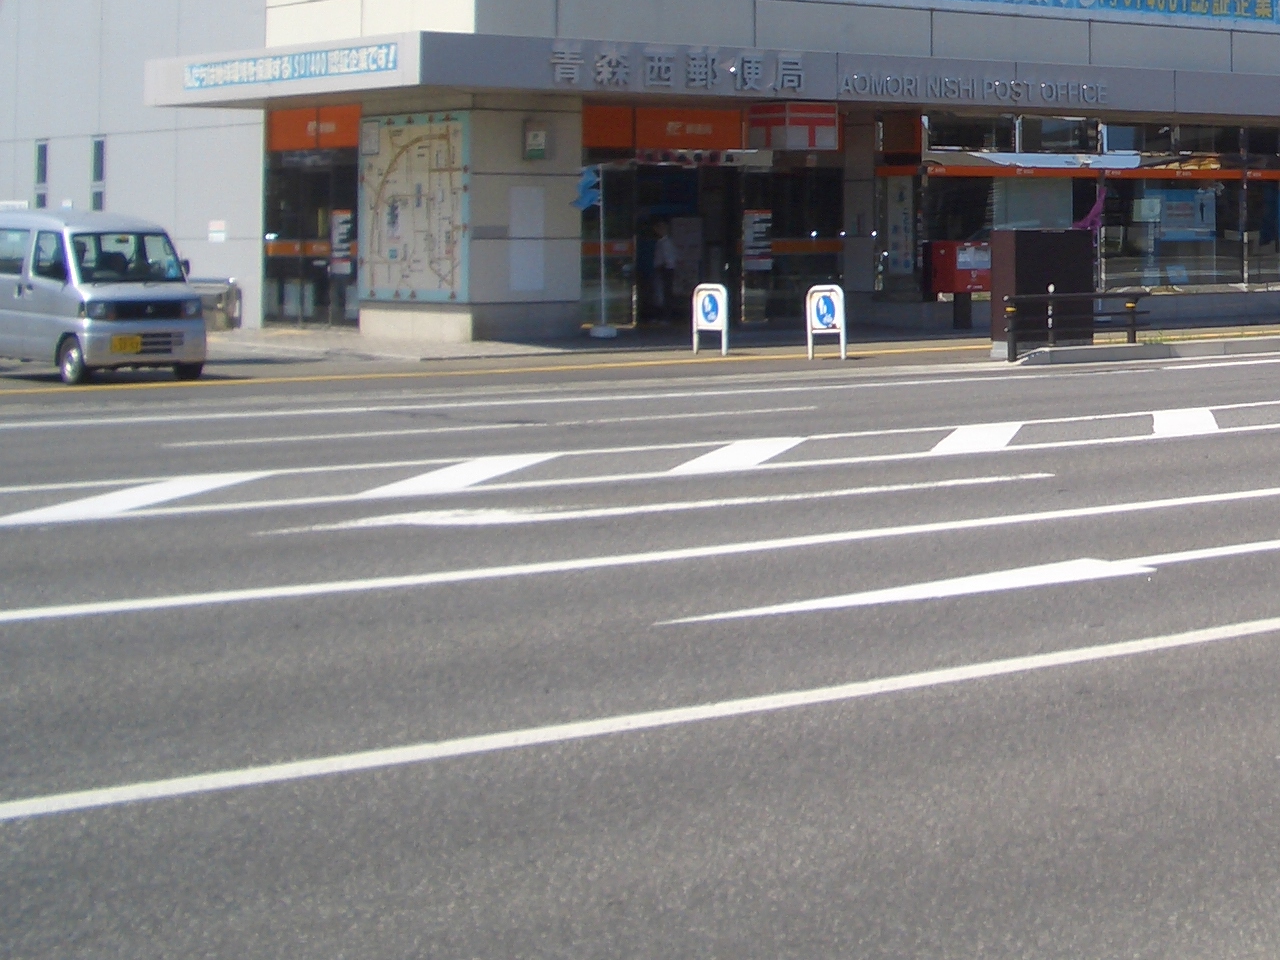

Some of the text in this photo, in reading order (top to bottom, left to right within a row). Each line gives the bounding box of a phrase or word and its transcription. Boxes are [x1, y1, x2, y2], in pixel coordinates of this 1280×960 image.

[551, 49, 804, 93] 青森西郵便局
[841, 73, 1108, 105] AOMORI NISHI POST OFFICE
